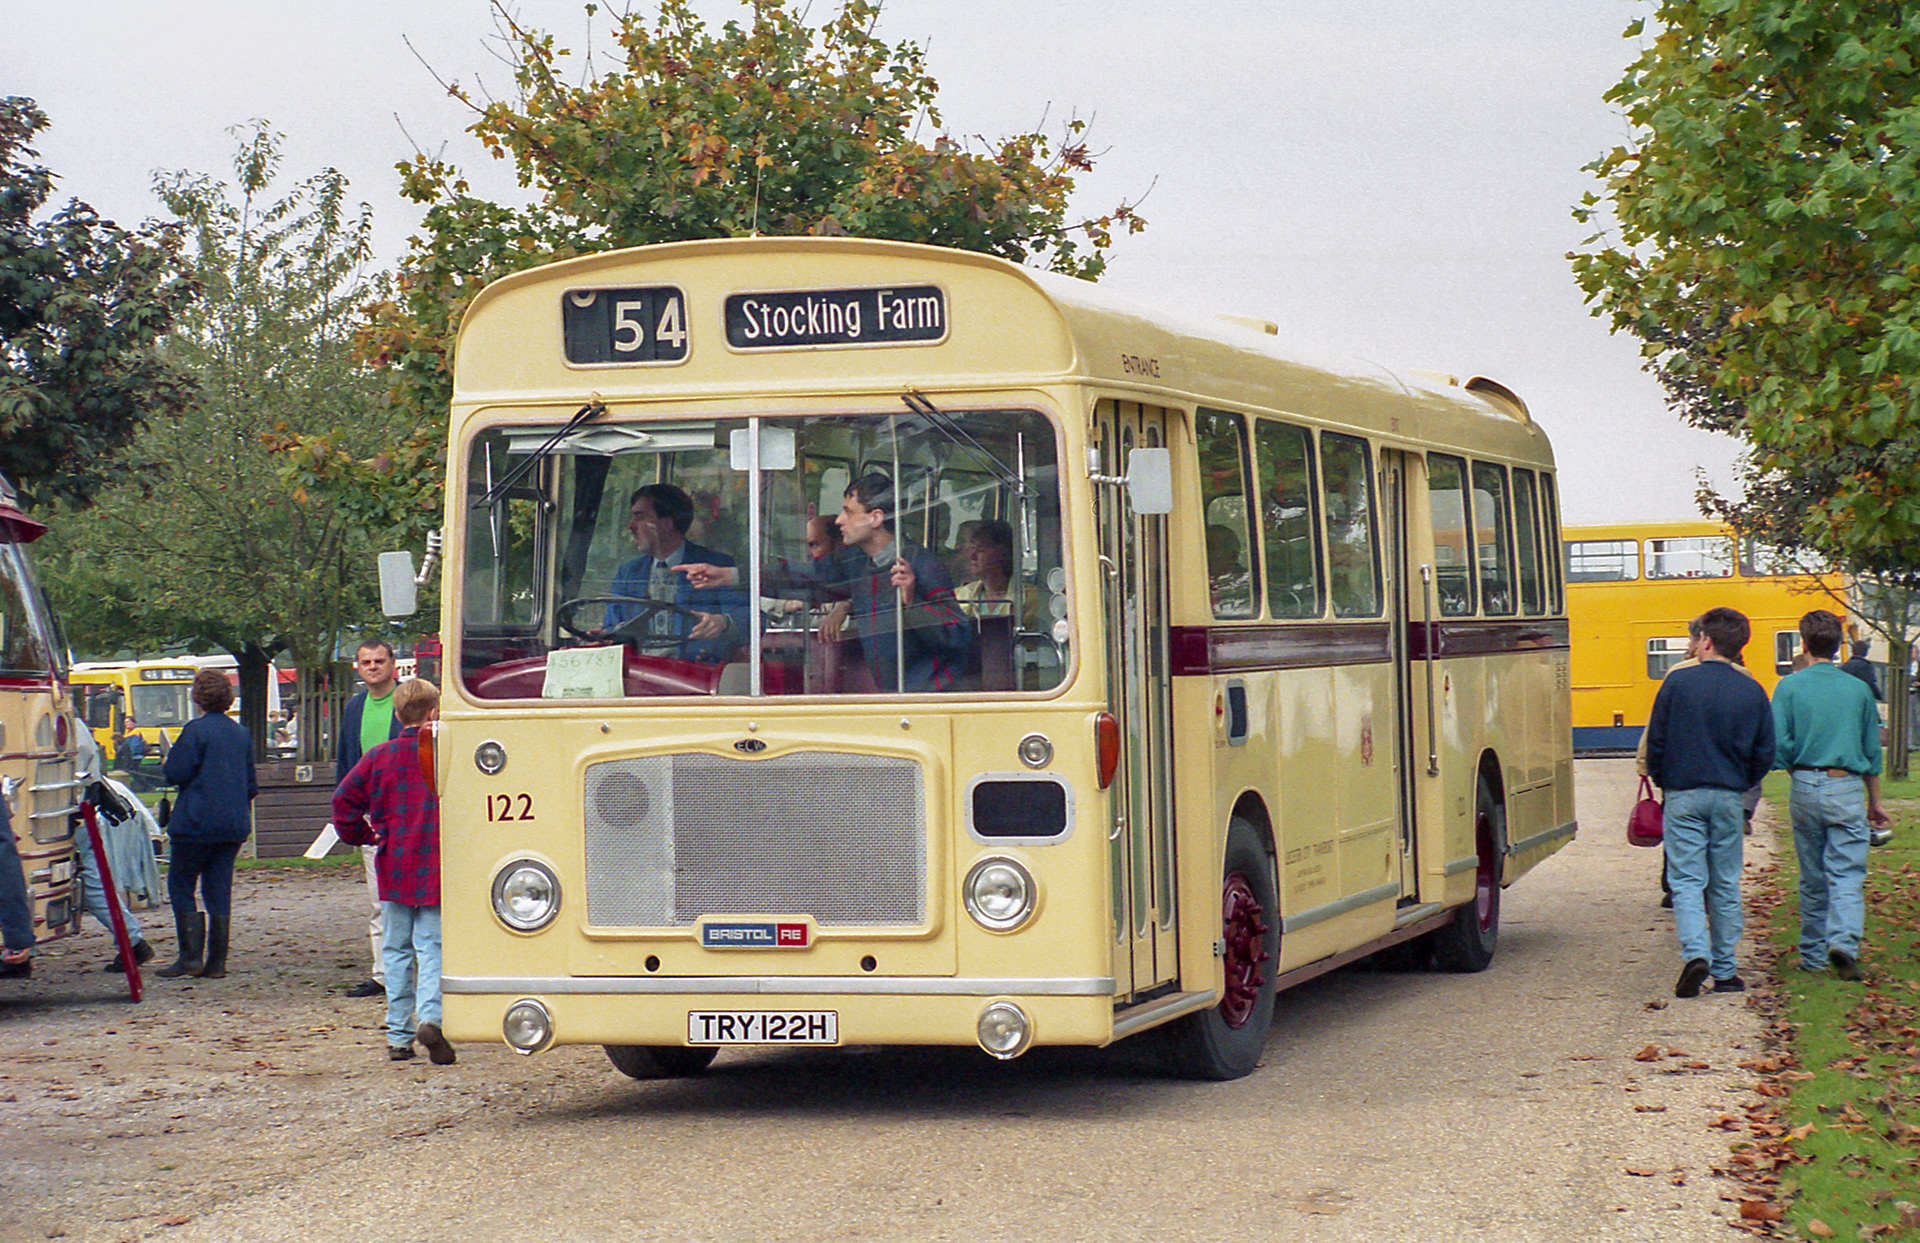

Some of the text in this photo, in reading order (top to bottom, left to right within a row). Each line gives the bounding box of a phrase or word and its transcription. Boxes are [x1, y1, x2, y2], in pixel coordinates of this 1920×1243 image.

[614, 297, 686, 352] 54
[742, 290, 940, 339] Stocking Farm
[1121, 353, 1161, 379] ENTRANCE
[487, 793, 535, 822] 122
[708, 929, 802, 940] BRISTOL RE
